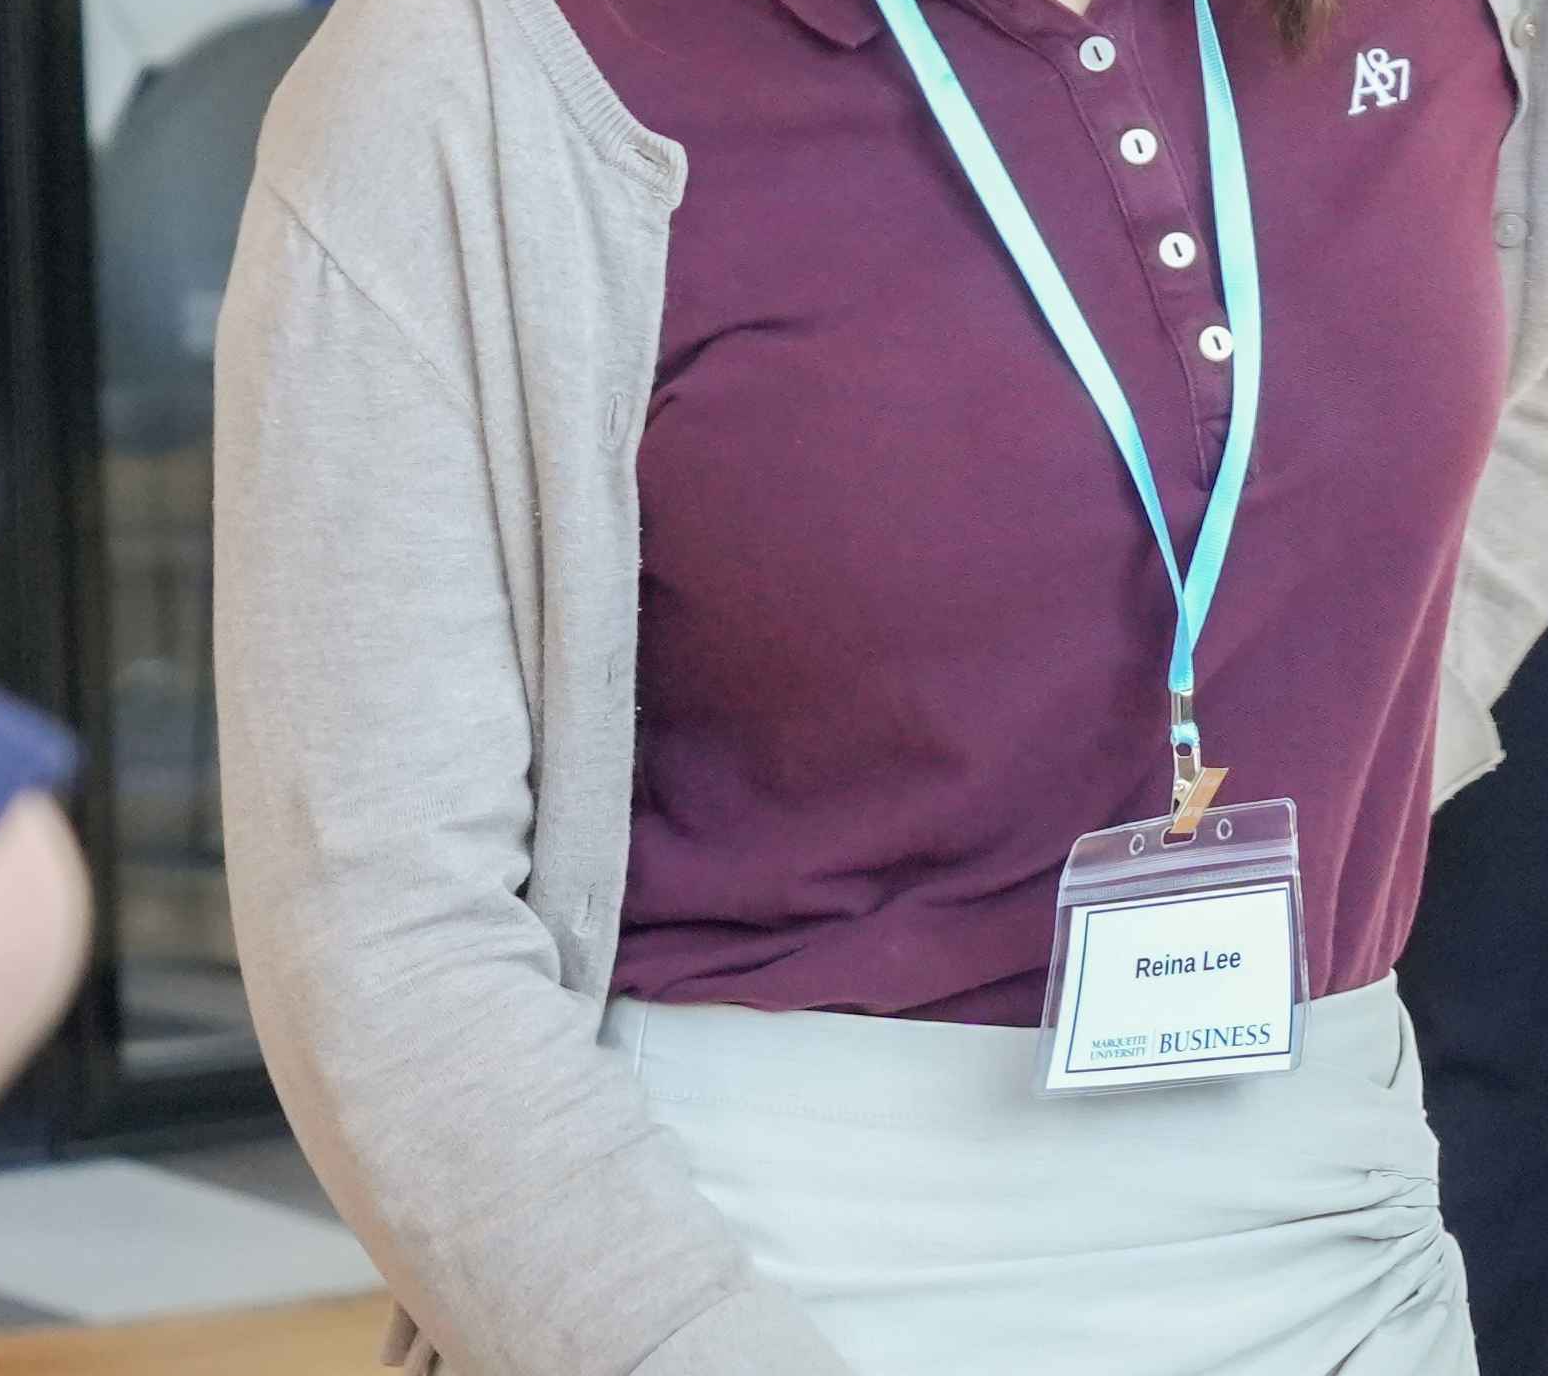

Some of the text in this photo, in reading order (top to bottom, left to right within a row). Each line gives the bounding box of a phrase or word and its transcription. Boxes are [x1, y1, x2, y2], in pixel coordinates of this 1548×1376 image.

[1135, 950, 1241, 979] Reina Lee
[1159, 1023, 1271, 1055] BUSINESS
